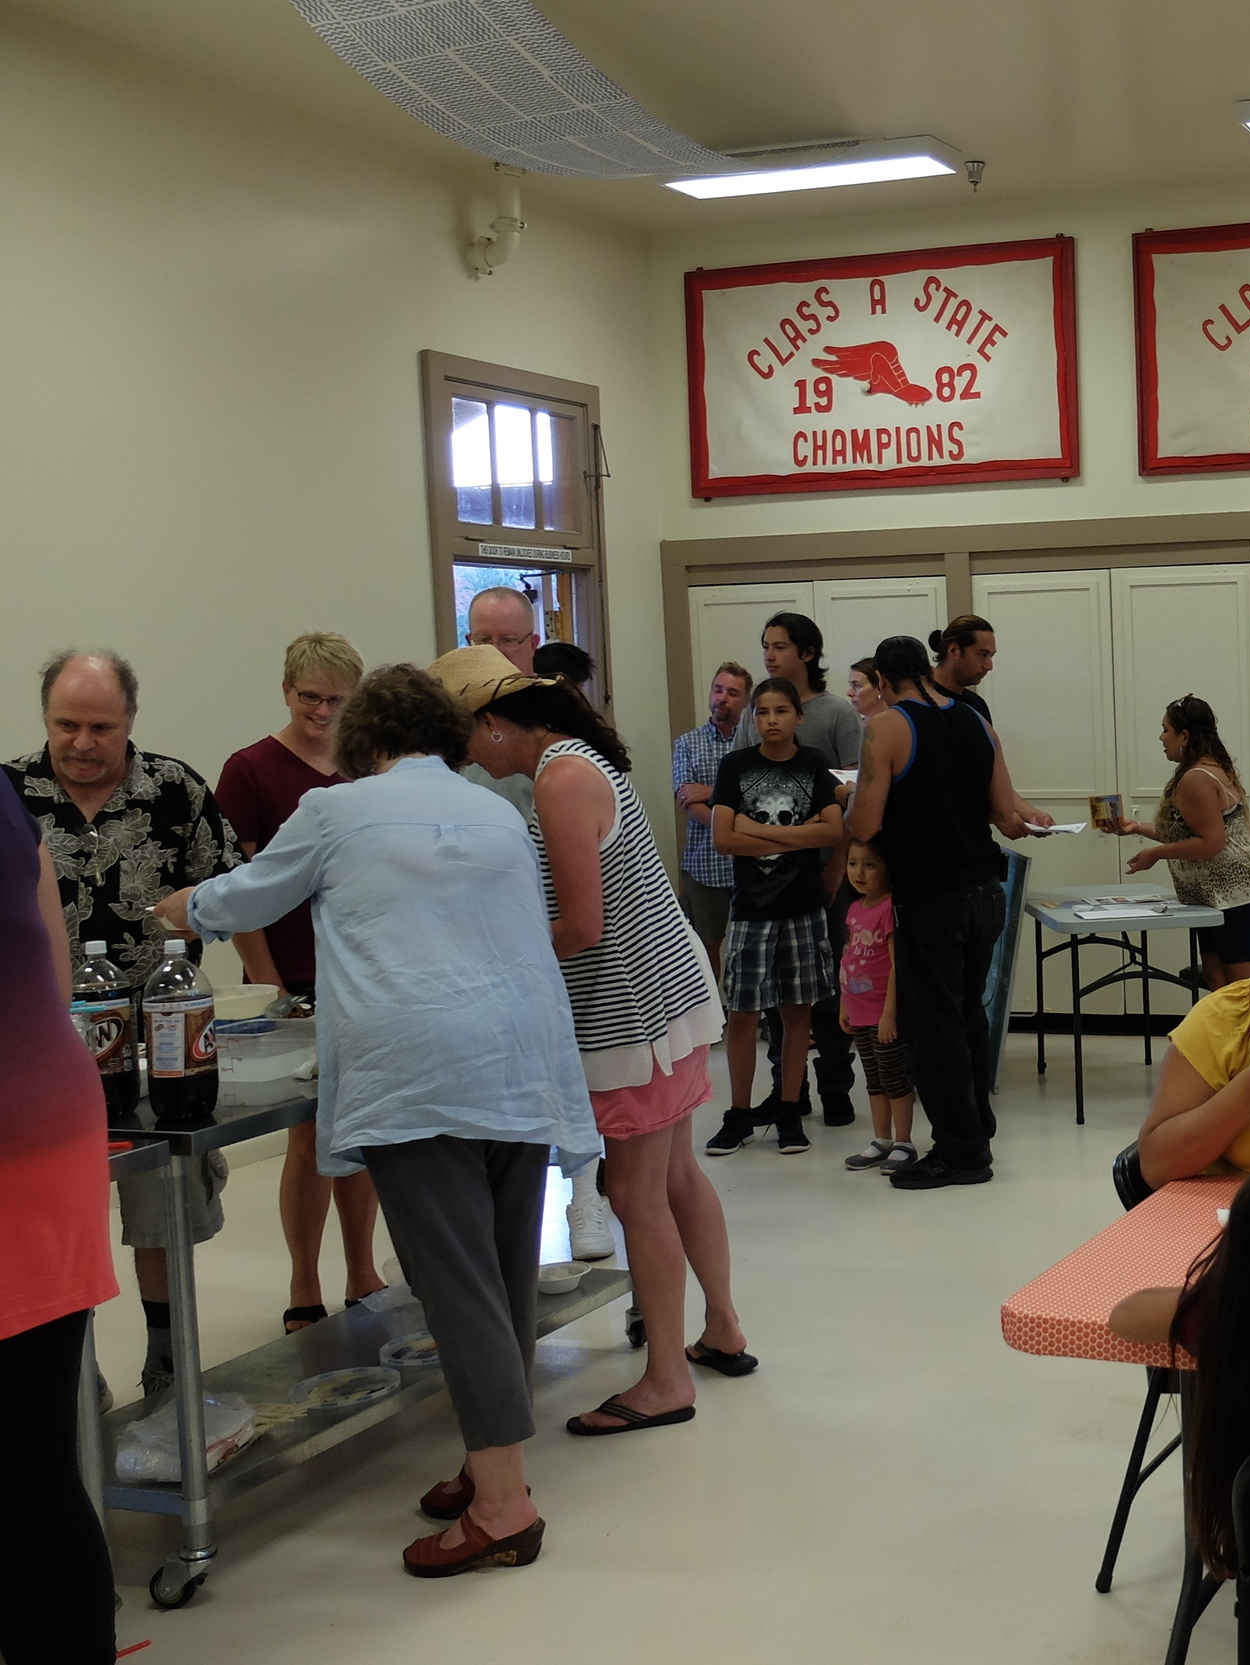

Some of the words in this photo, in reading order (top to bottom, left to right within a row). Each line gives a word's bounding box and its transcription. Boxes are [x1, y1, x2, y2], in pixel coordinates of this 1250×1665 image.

[746, 286, 841, 380] CLASS
[868, 278, 888, 315] A
[913, 275, 1009, 363] STATE
[792, 376, 834, 415] 19
[935, 362, 982, 403] 82
[792, 421, 966, 468] CHAMPIONS
